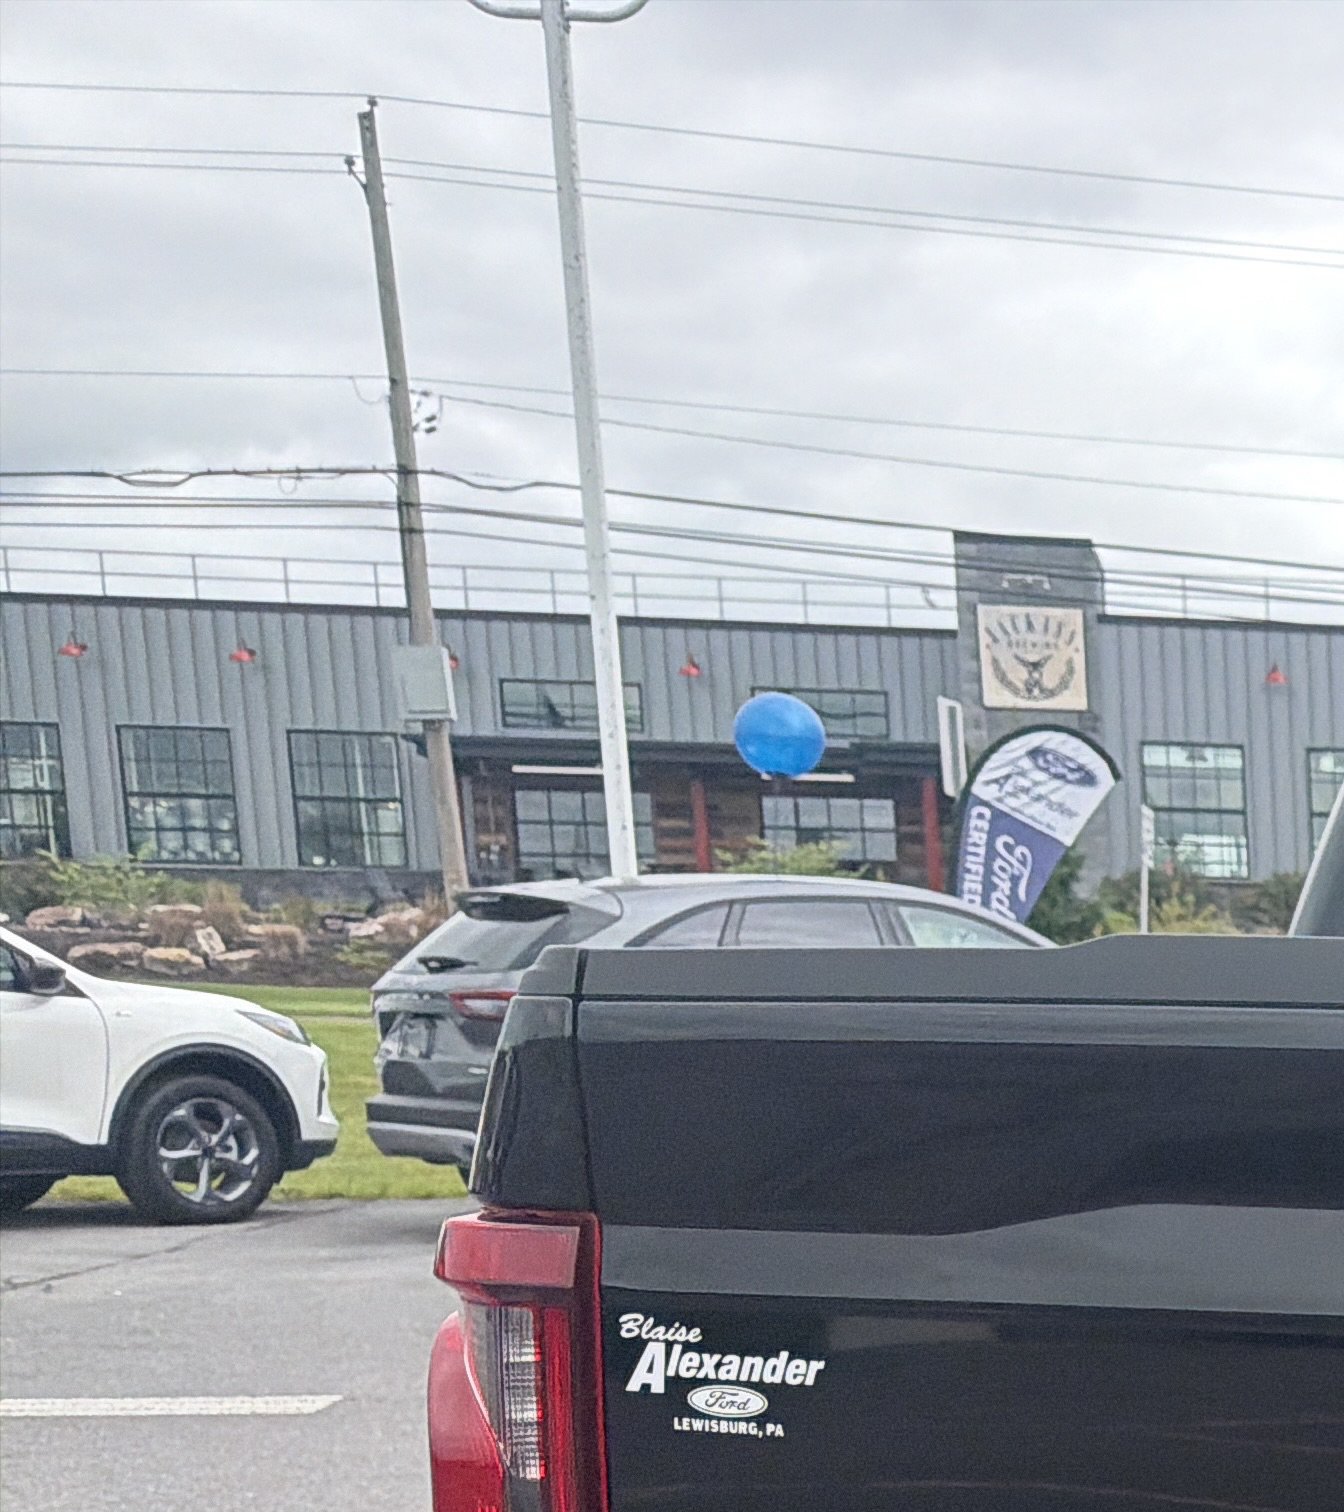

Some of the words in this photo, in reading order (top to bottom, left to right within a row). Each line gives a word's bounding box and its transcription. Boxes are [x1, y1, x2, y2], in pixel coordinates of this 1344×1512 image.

[990, 834, 1032, 921] Ford
[618, 1312, 703, 1343] Blaise
[625, 1341, 825, 1394] Alexander
[704, 1390, 751, 1412] Ford
[673, 1416, 764, 1439] LEWISBURG,
[765, 1423, 784, 1437] PA
